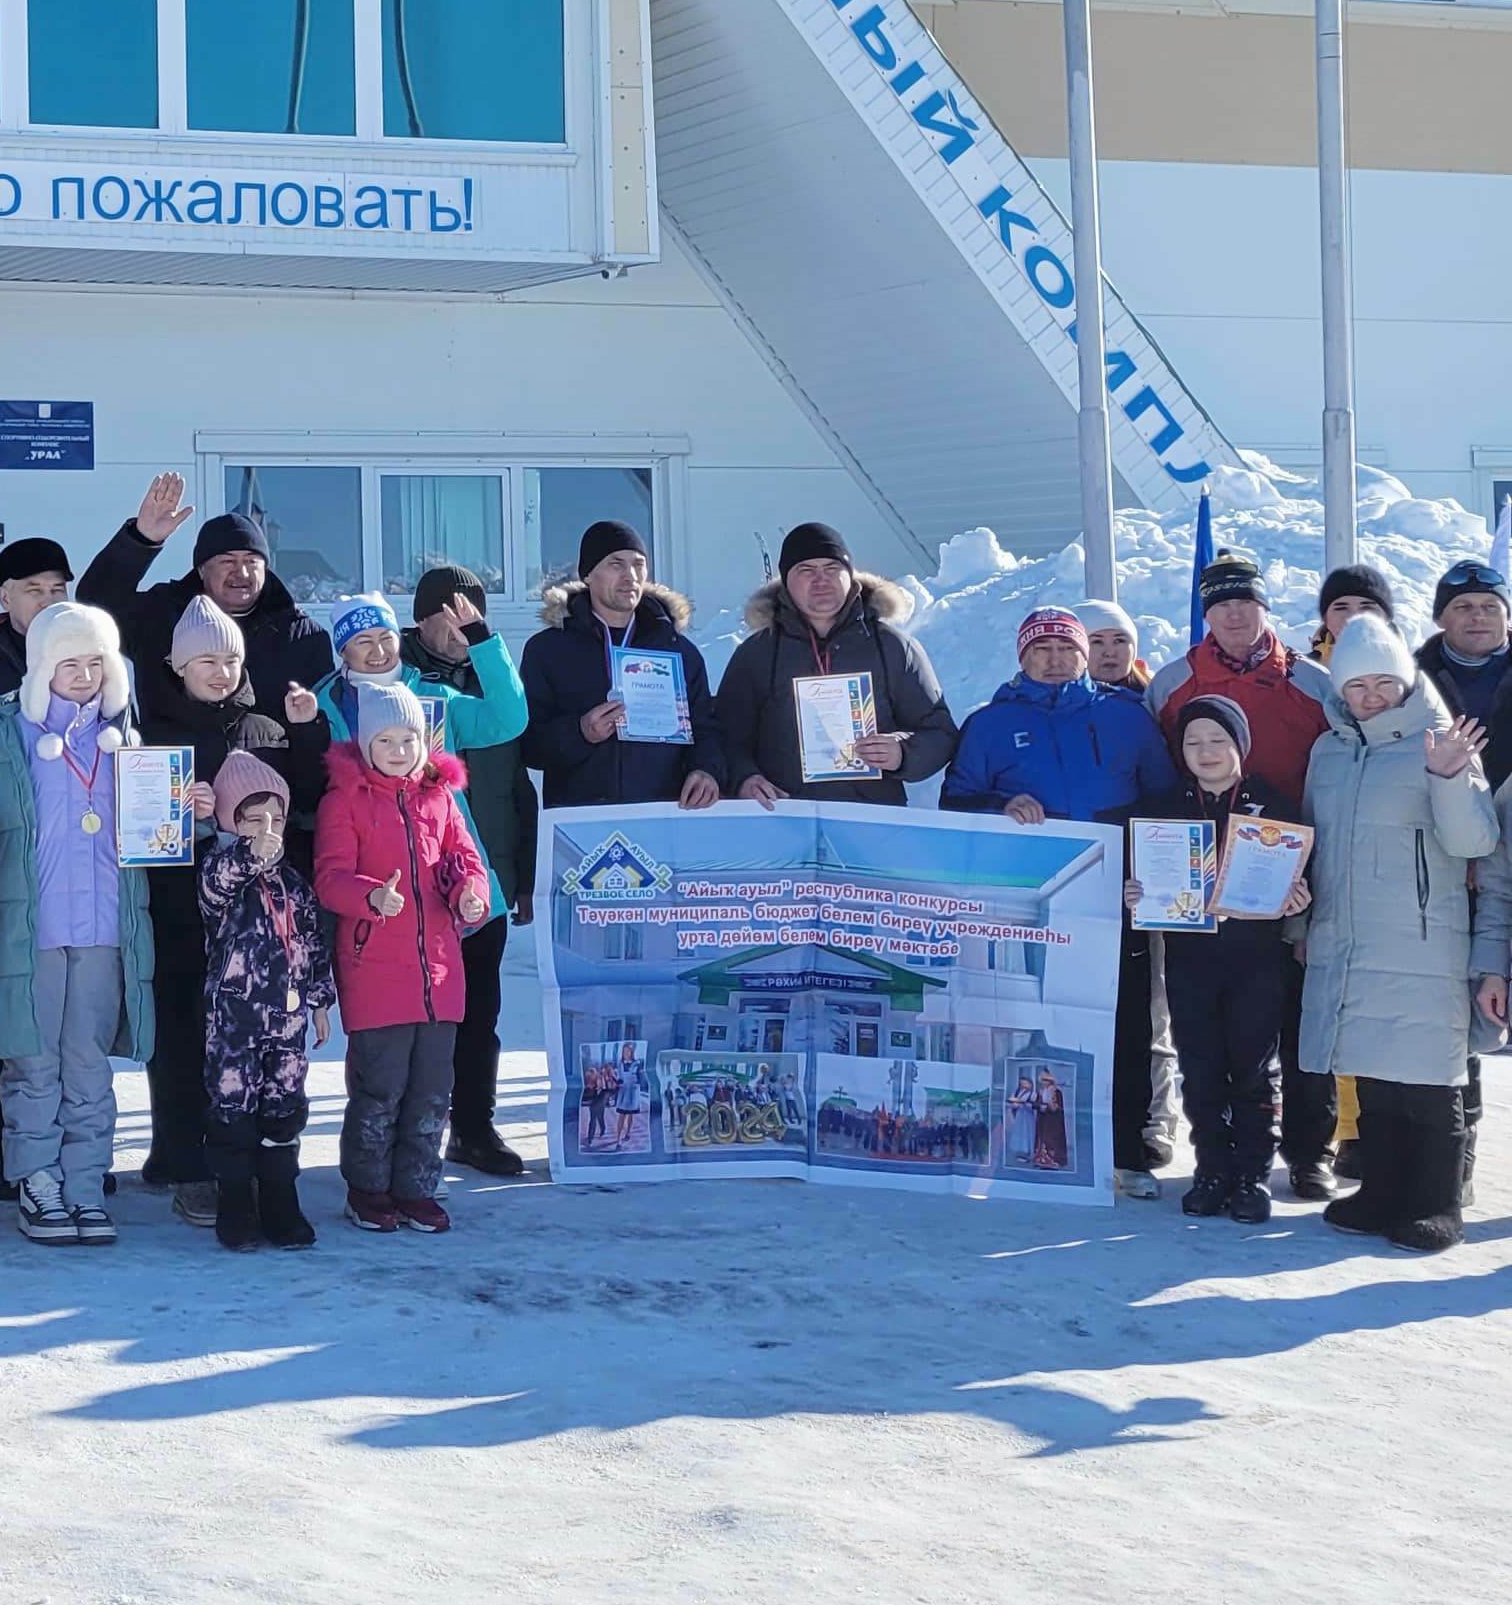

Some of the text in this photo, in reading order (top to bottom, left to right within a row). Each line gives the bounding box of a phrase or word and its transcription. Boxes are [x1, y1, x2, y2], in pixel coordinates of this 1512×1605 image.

[52, 175, 473, 232] пожаловать!
[625, 889, 654, 899] СЕЛО
[795, 884, 893, 904] республика
[898, 891, 983, 914] конкурсы
[648, 906, 750, 923] муниципаль
[755, 904, 818, 921] бюджет
[821, 906, 875, 925] белем
[678, 931, 716, 947] урта
[779, 928, 826, 944] белем
[681, 1100, 788, 1147] 2024
